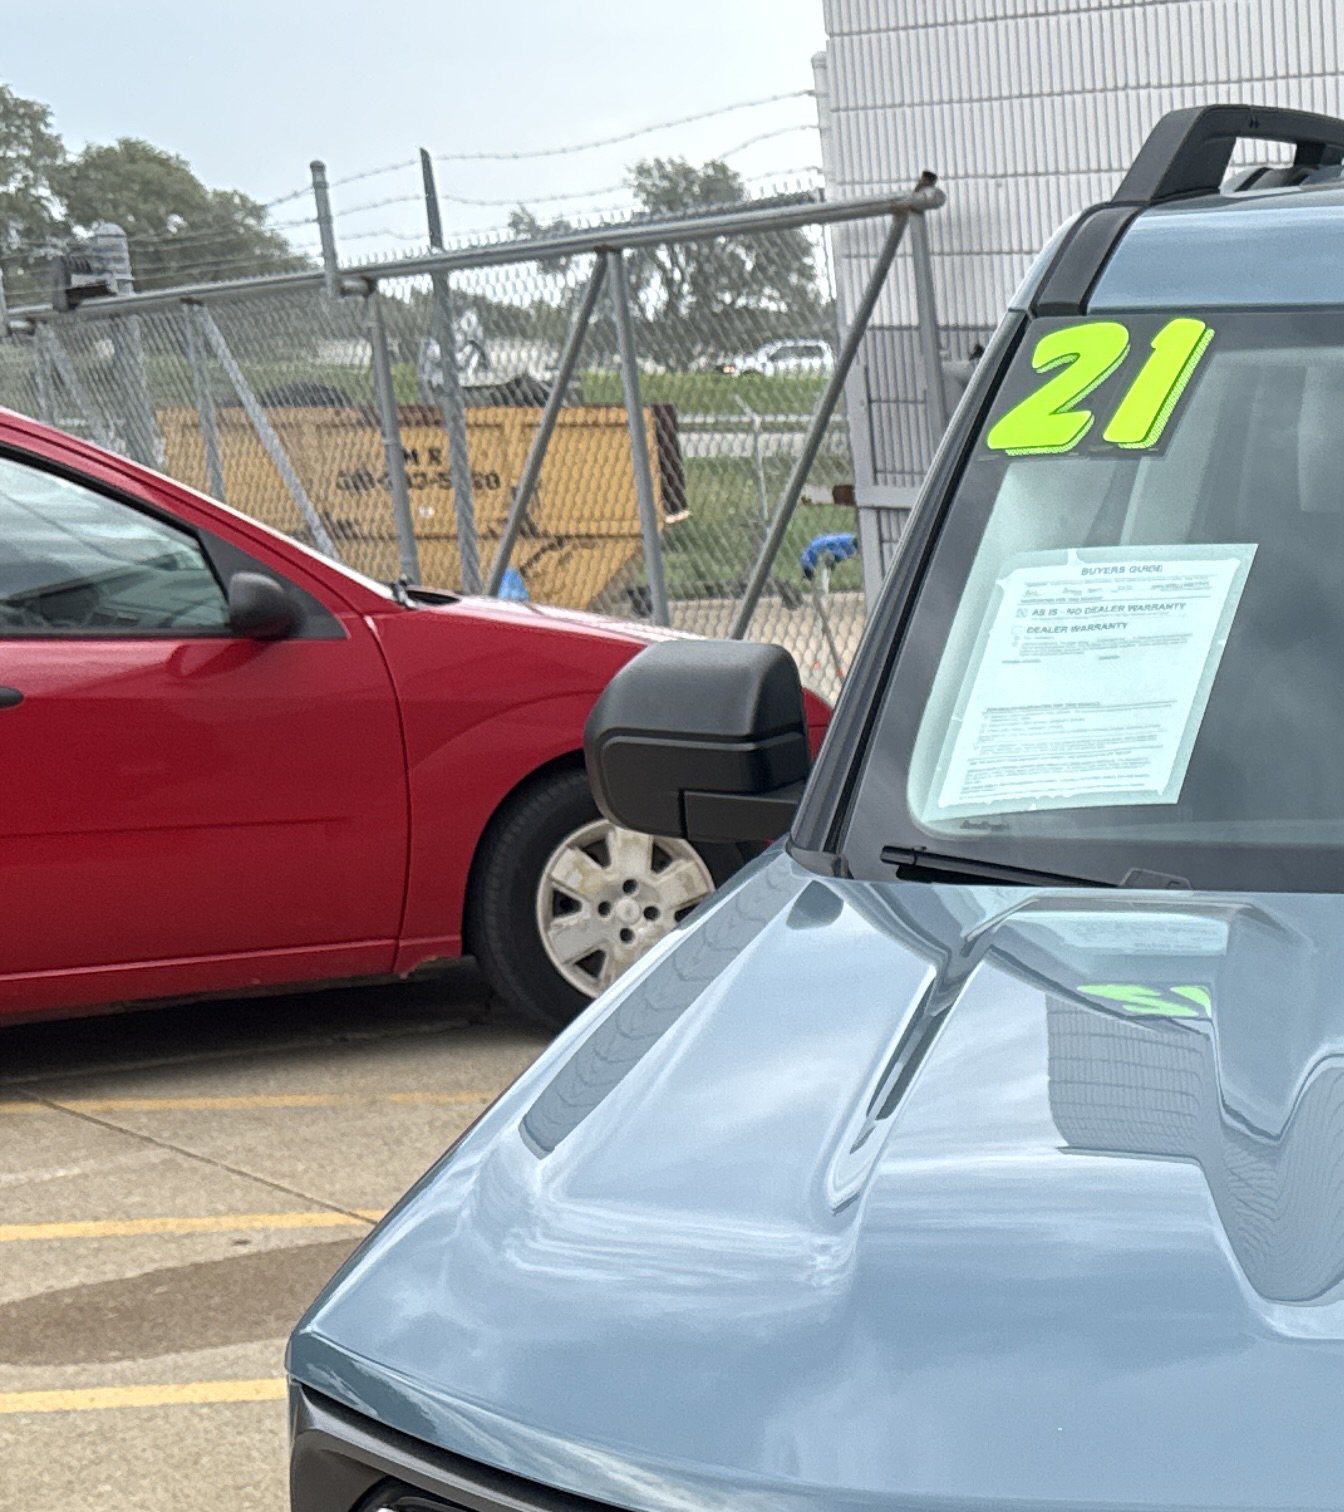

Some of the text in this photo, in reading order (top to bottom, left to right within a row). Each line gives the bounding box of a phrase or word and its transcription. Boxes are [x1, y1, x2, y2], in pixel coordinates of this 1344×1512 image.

[985, 318, 1216, 456] 21
[1081, 564, 1163, 576] BUYERS GUIDE
[1031, 608, 1046, 616] AS
[1048, 608, 1058, 616] IS
[1066, 607, 1082, 616] NO
[1084, 605, 1125, 615] DEALER
[1127, 602, 1186, 612] WARRANTY
[1026, 622, 1128, 634] DEALER WARRANTY
